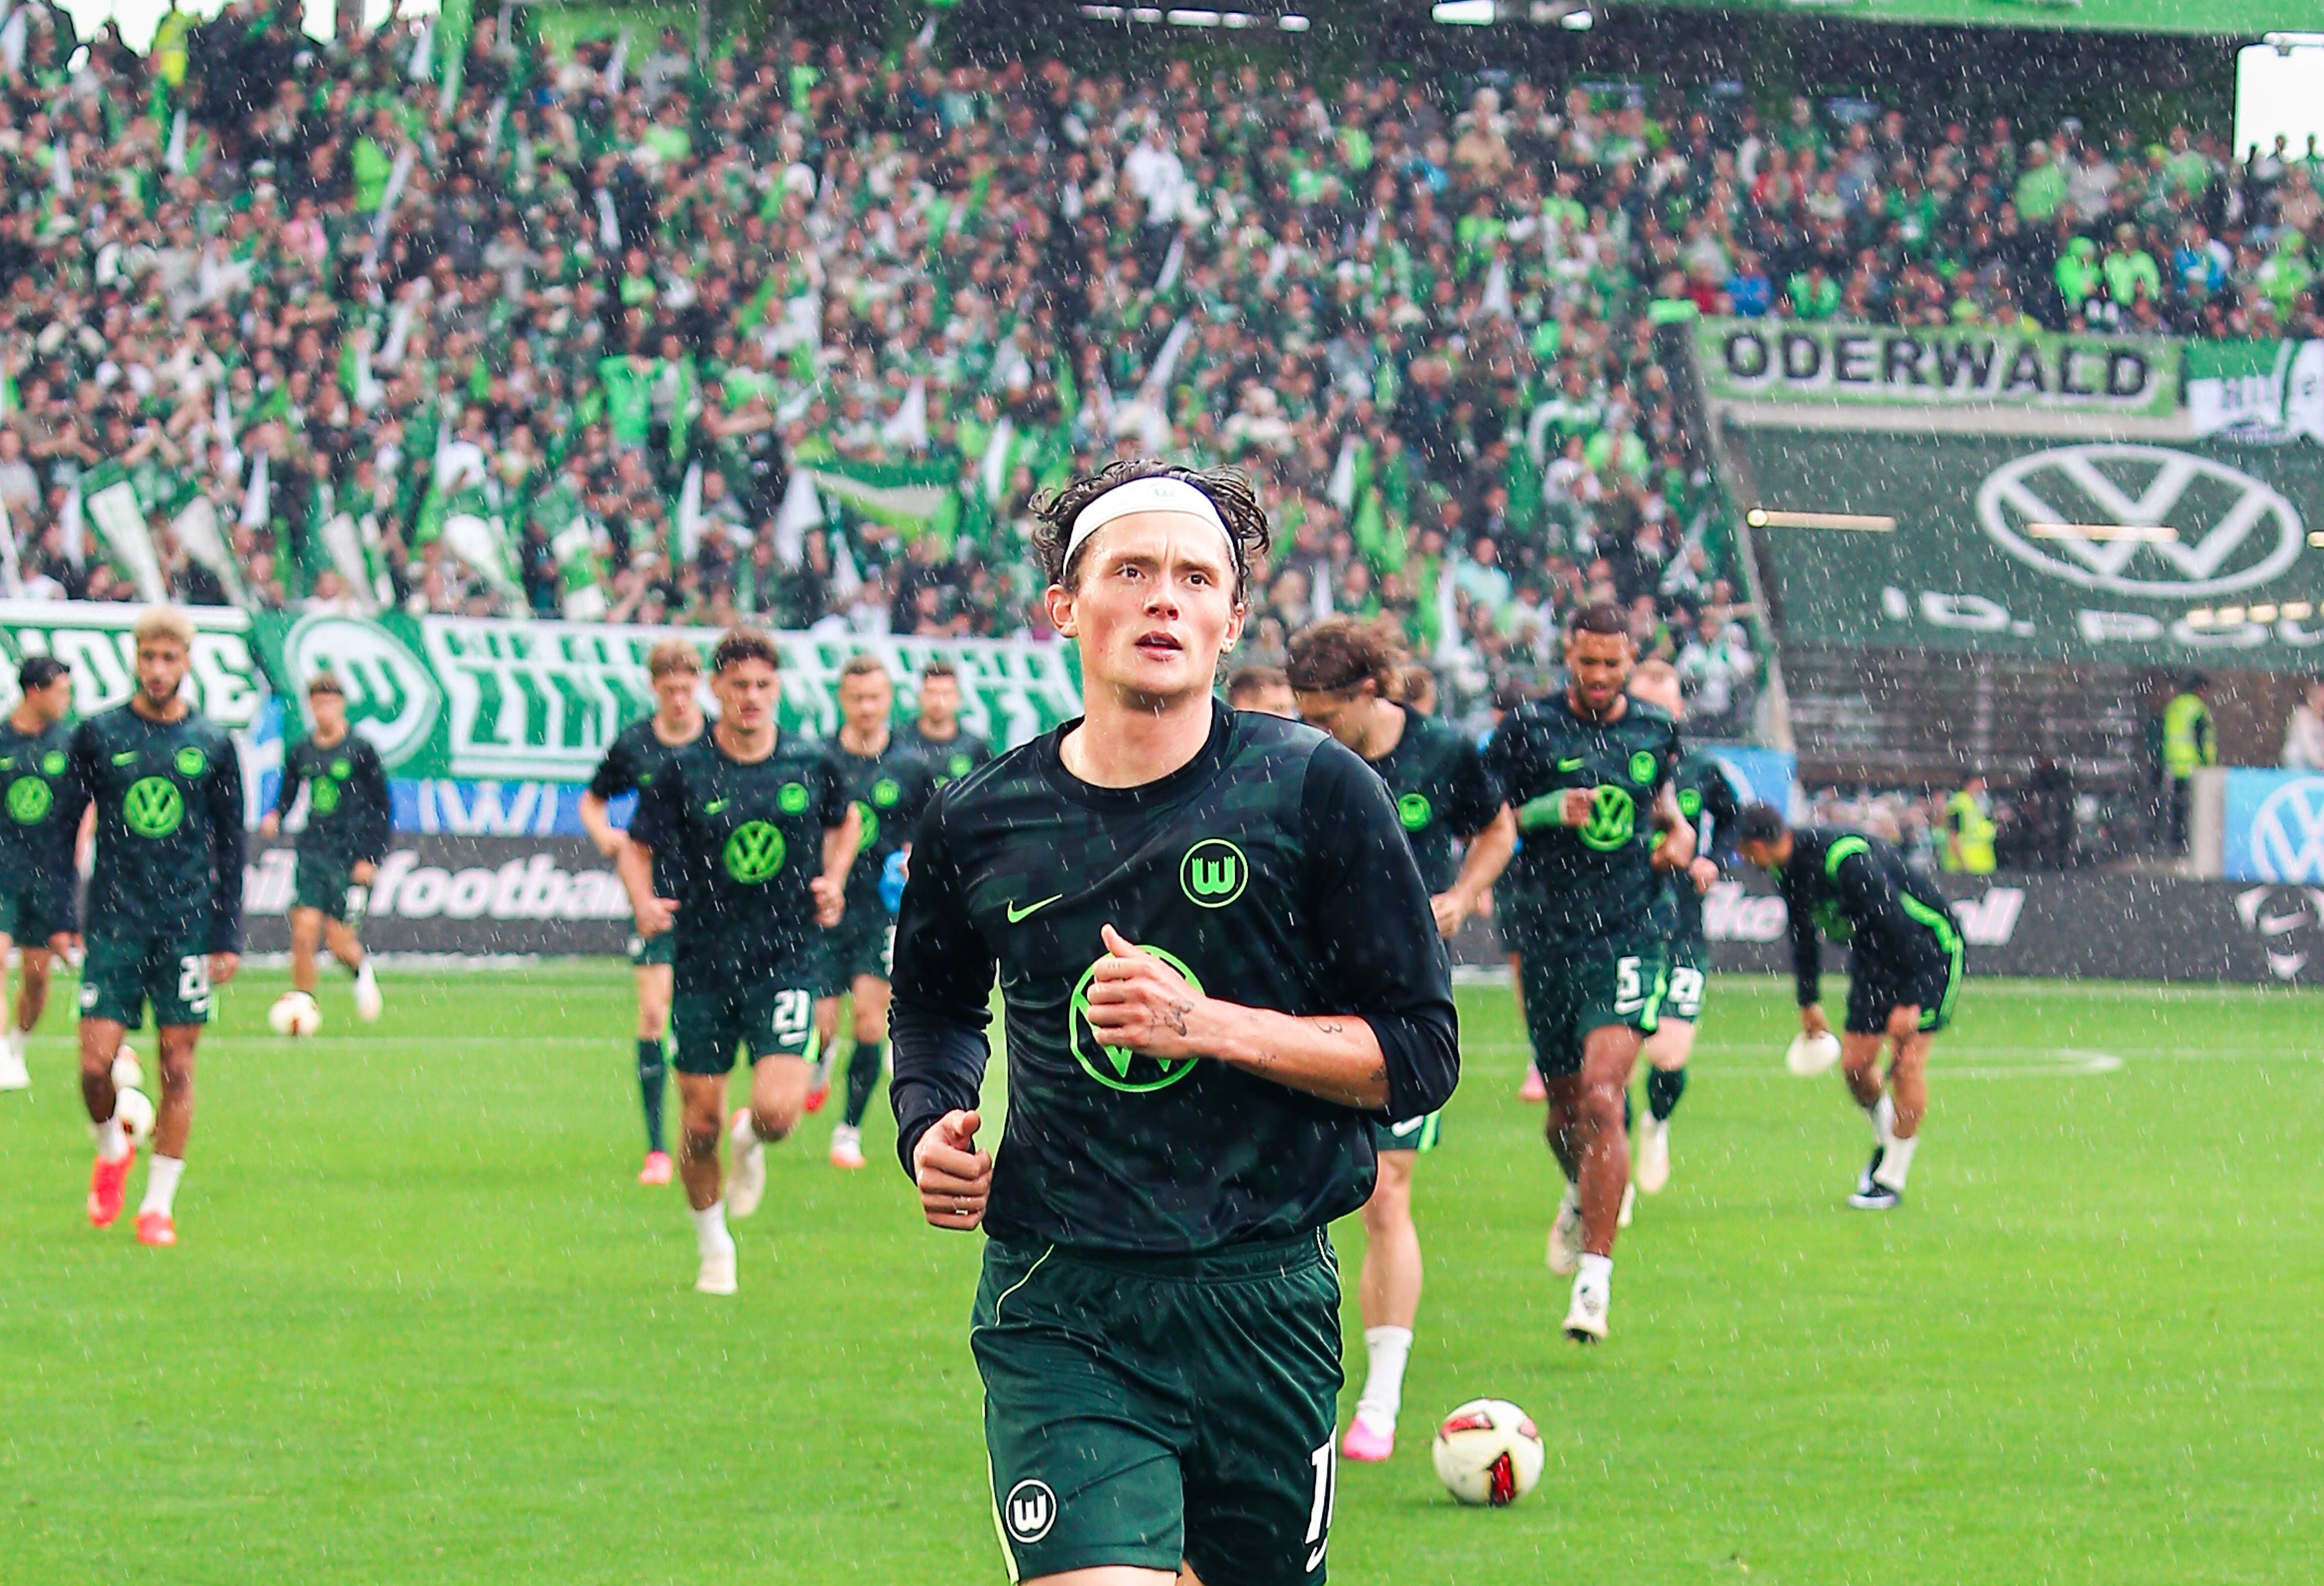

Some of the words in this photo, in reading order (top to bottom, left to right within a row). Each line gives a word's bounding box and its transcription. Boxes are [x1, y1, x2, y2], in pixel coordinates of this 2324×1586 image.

[1723, 330, 2149, 398] ODERWALD
[367, 849, 634, 920] footbal
[1616, 956, 1642, 1001] 5
[772, 988, 812, 1034] 21
